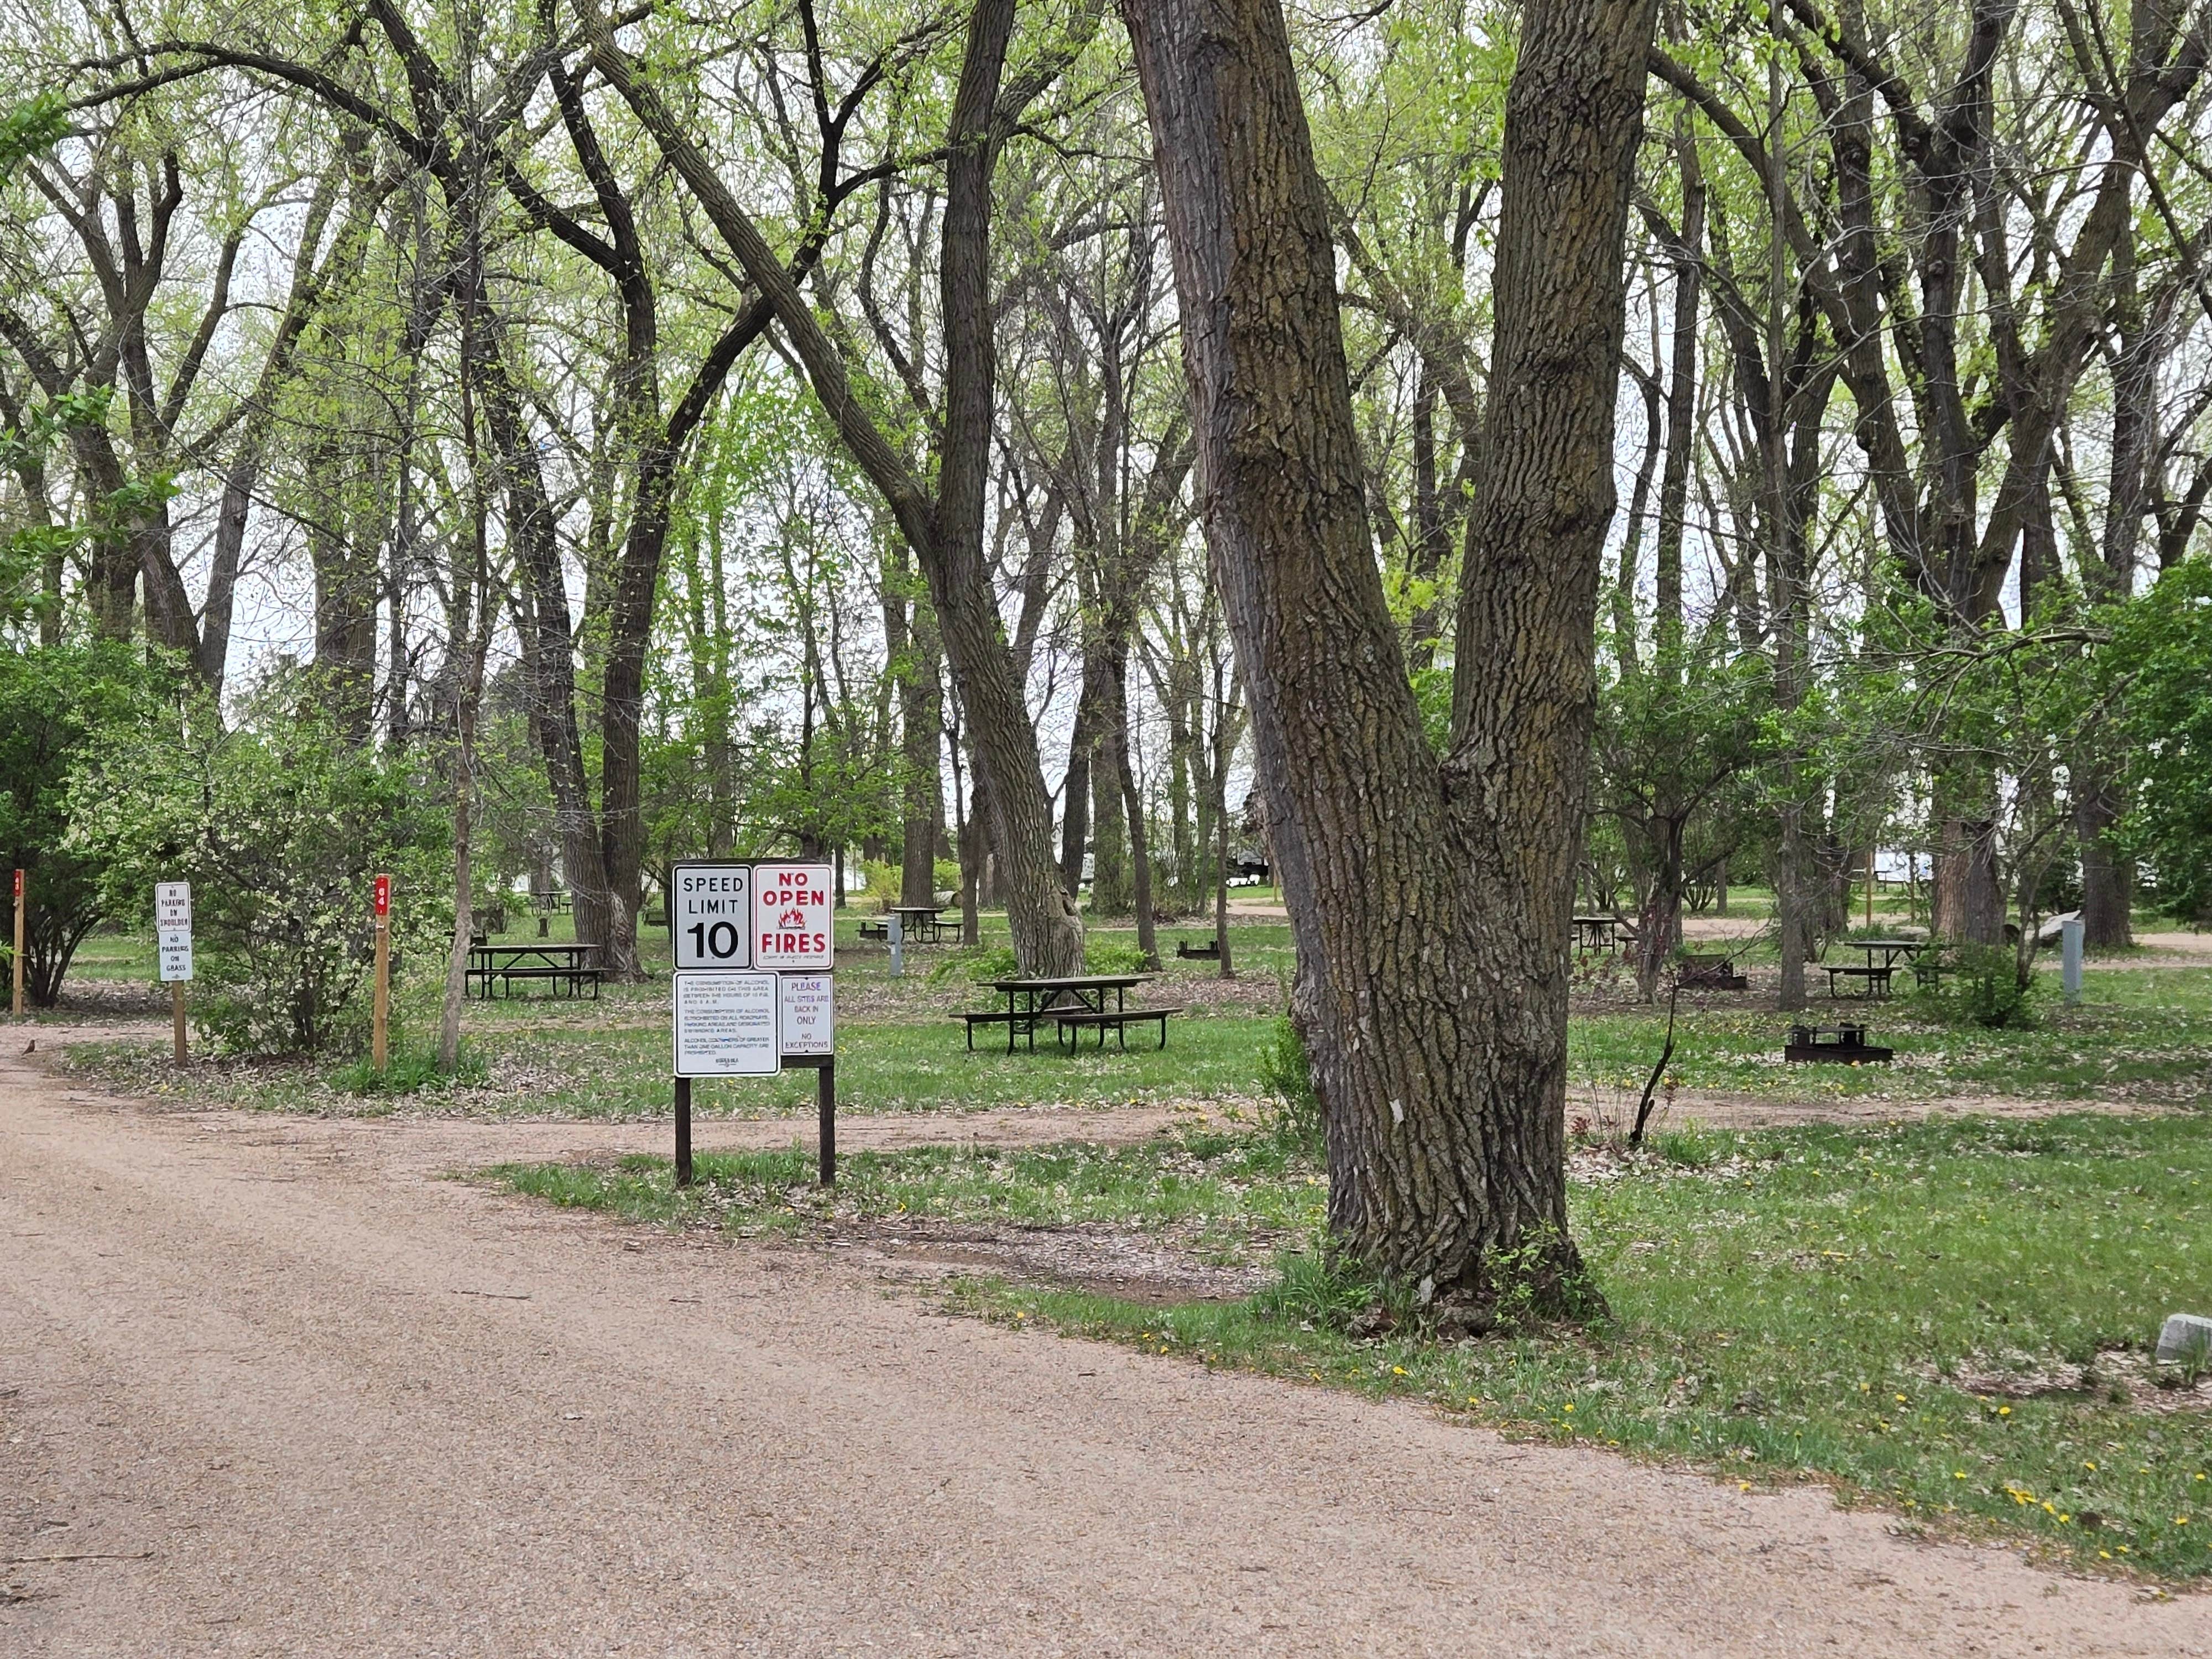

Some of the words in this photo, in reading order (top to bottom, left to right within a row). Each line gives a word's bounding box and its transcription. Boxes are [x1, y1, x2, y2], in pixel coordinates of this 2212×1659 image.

[683, 878, 743, 892] SPEED
[779, 873, 808, 886] NO
[161, 899, 185, 907] PARKING
[763, 891, 824, 906] OPEN
[688, 900, 738, 914] LIMIT
[160, 918, 188, 927] SHOULDER
[687, 921, 738, 959] 10
[761, 933, 826, 953] FIRES
[791, 982, 822, 992] PLEASE
[796, 1016, 816, 1025] ONLY
